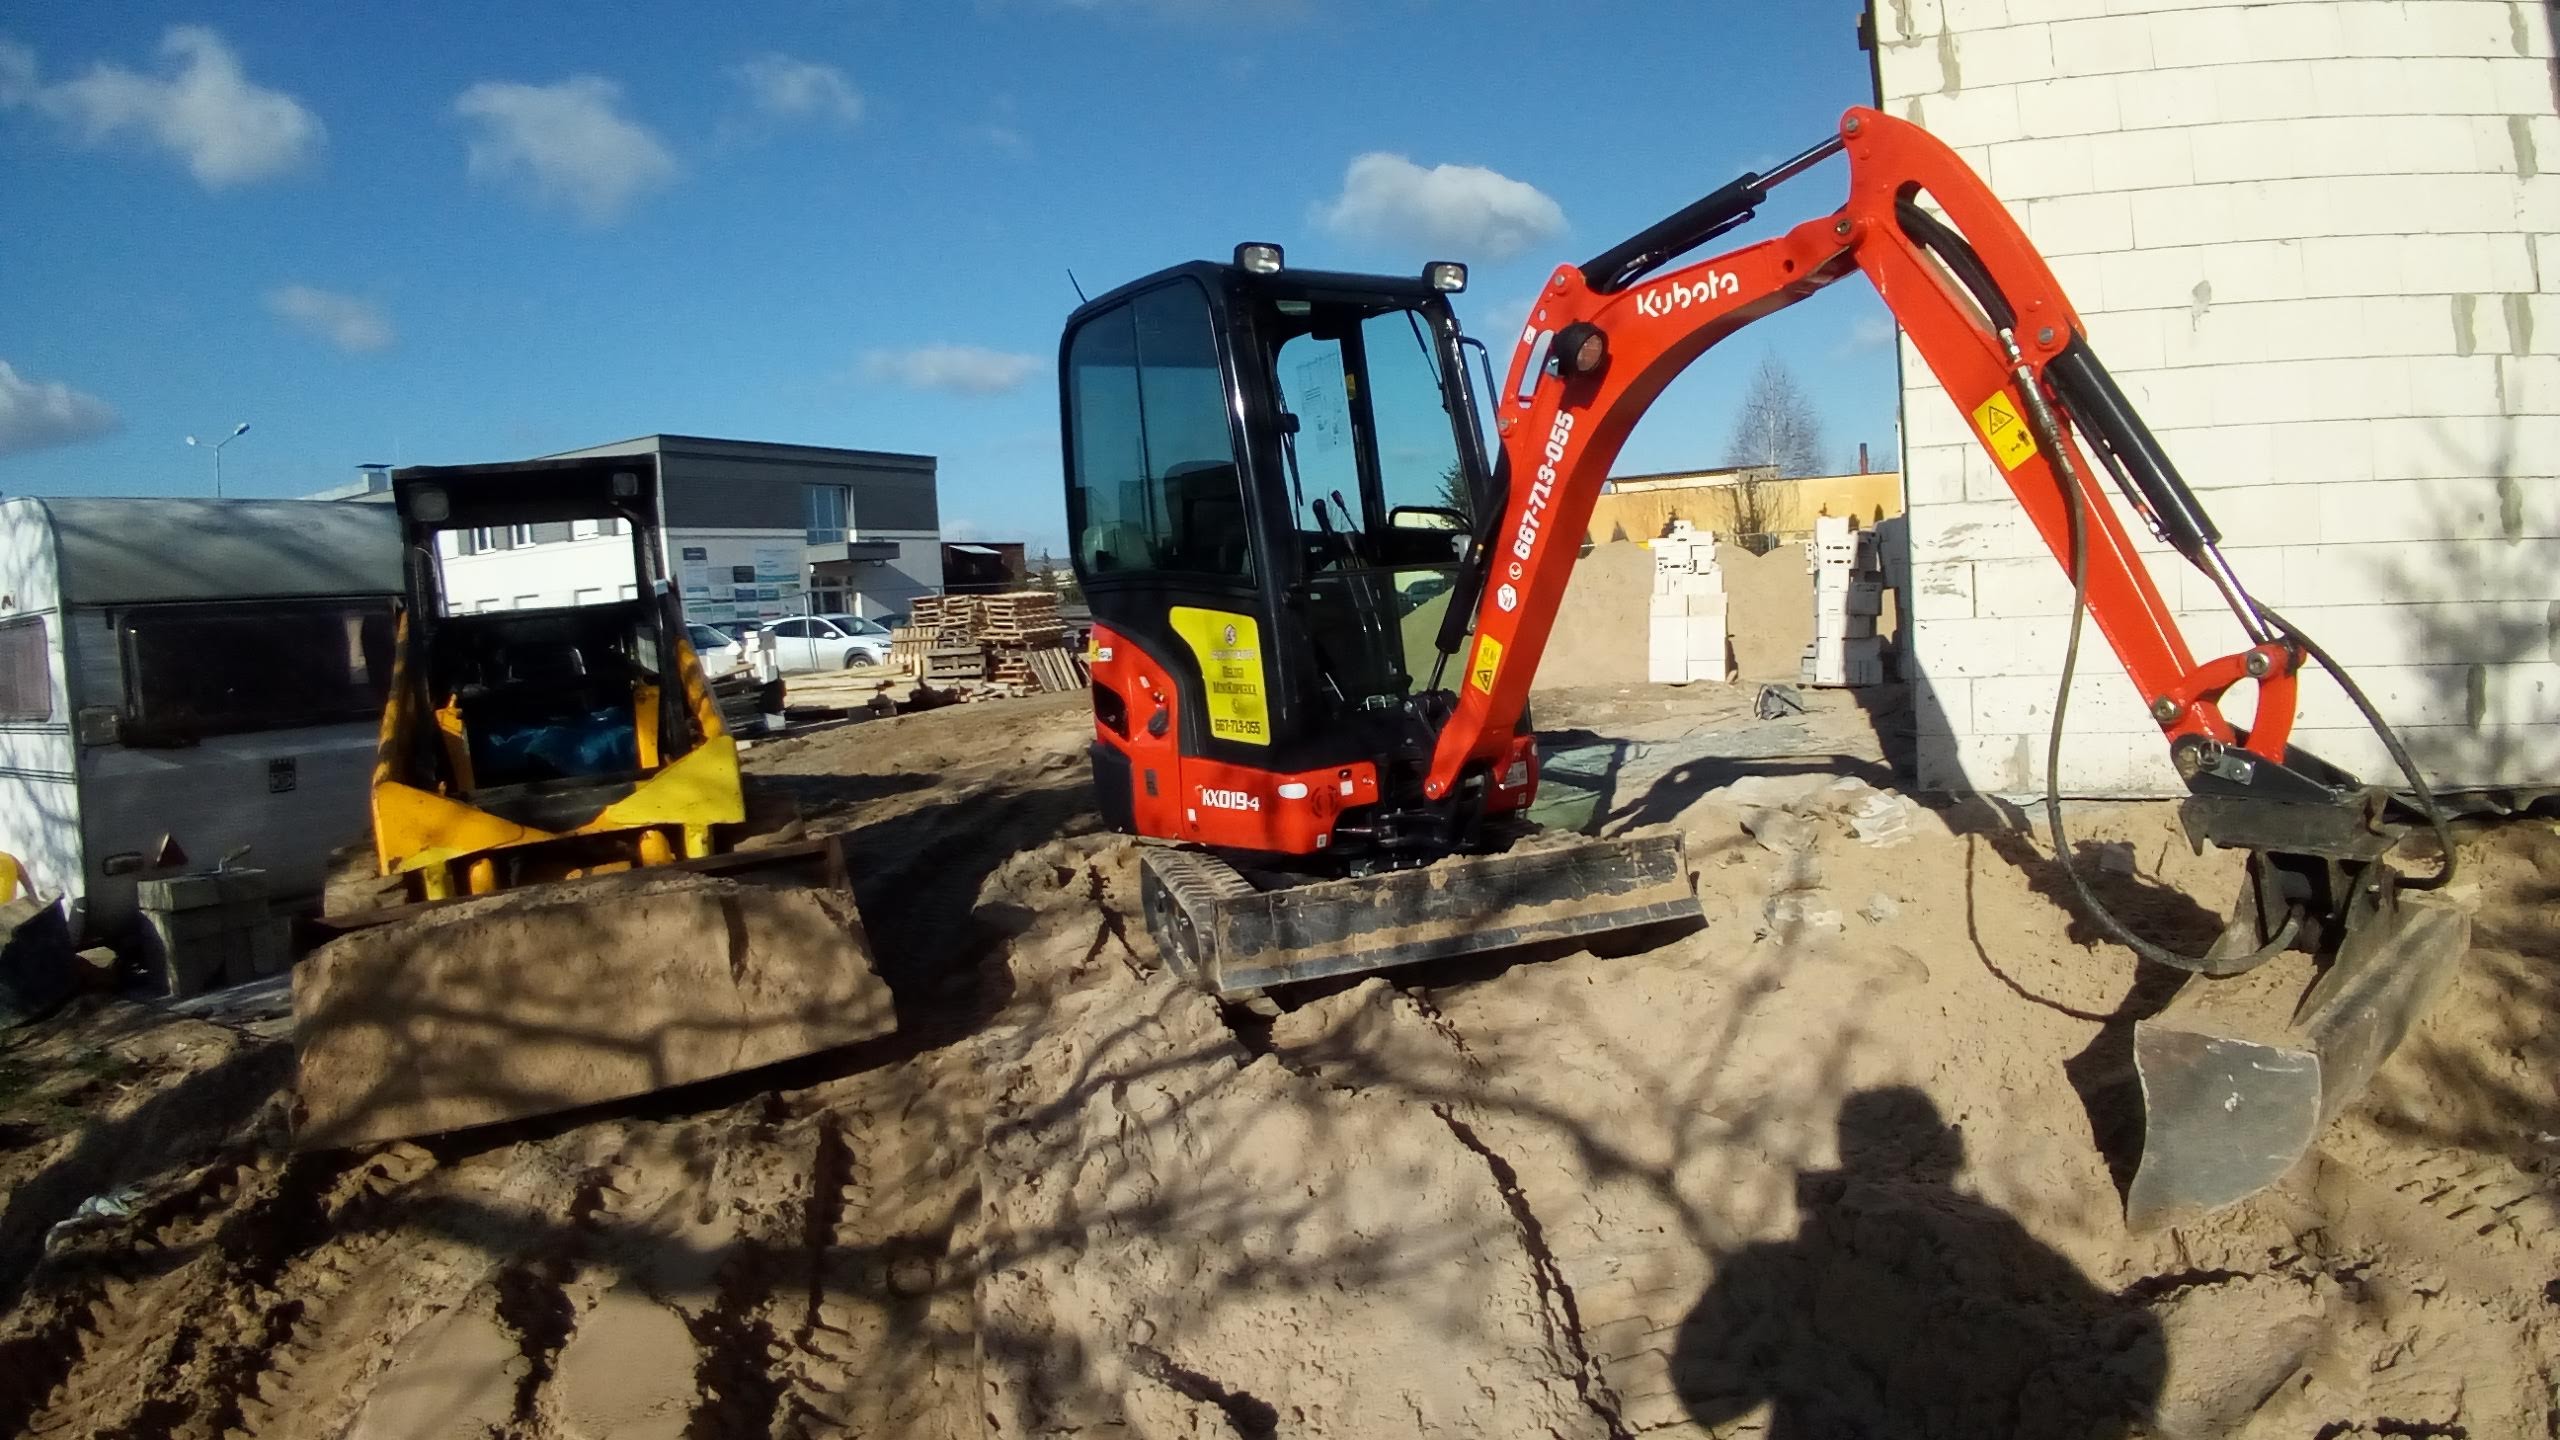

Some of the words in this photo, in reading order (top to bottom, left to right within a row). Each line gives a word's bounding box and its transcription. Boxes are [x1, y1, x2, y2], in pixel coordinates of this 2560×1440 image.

[1636, 269, 1739, 317] Kubota
[1513, 409, 1574, 560] 667-713-055
[1202, 788, 1260, 812] KX019-4
